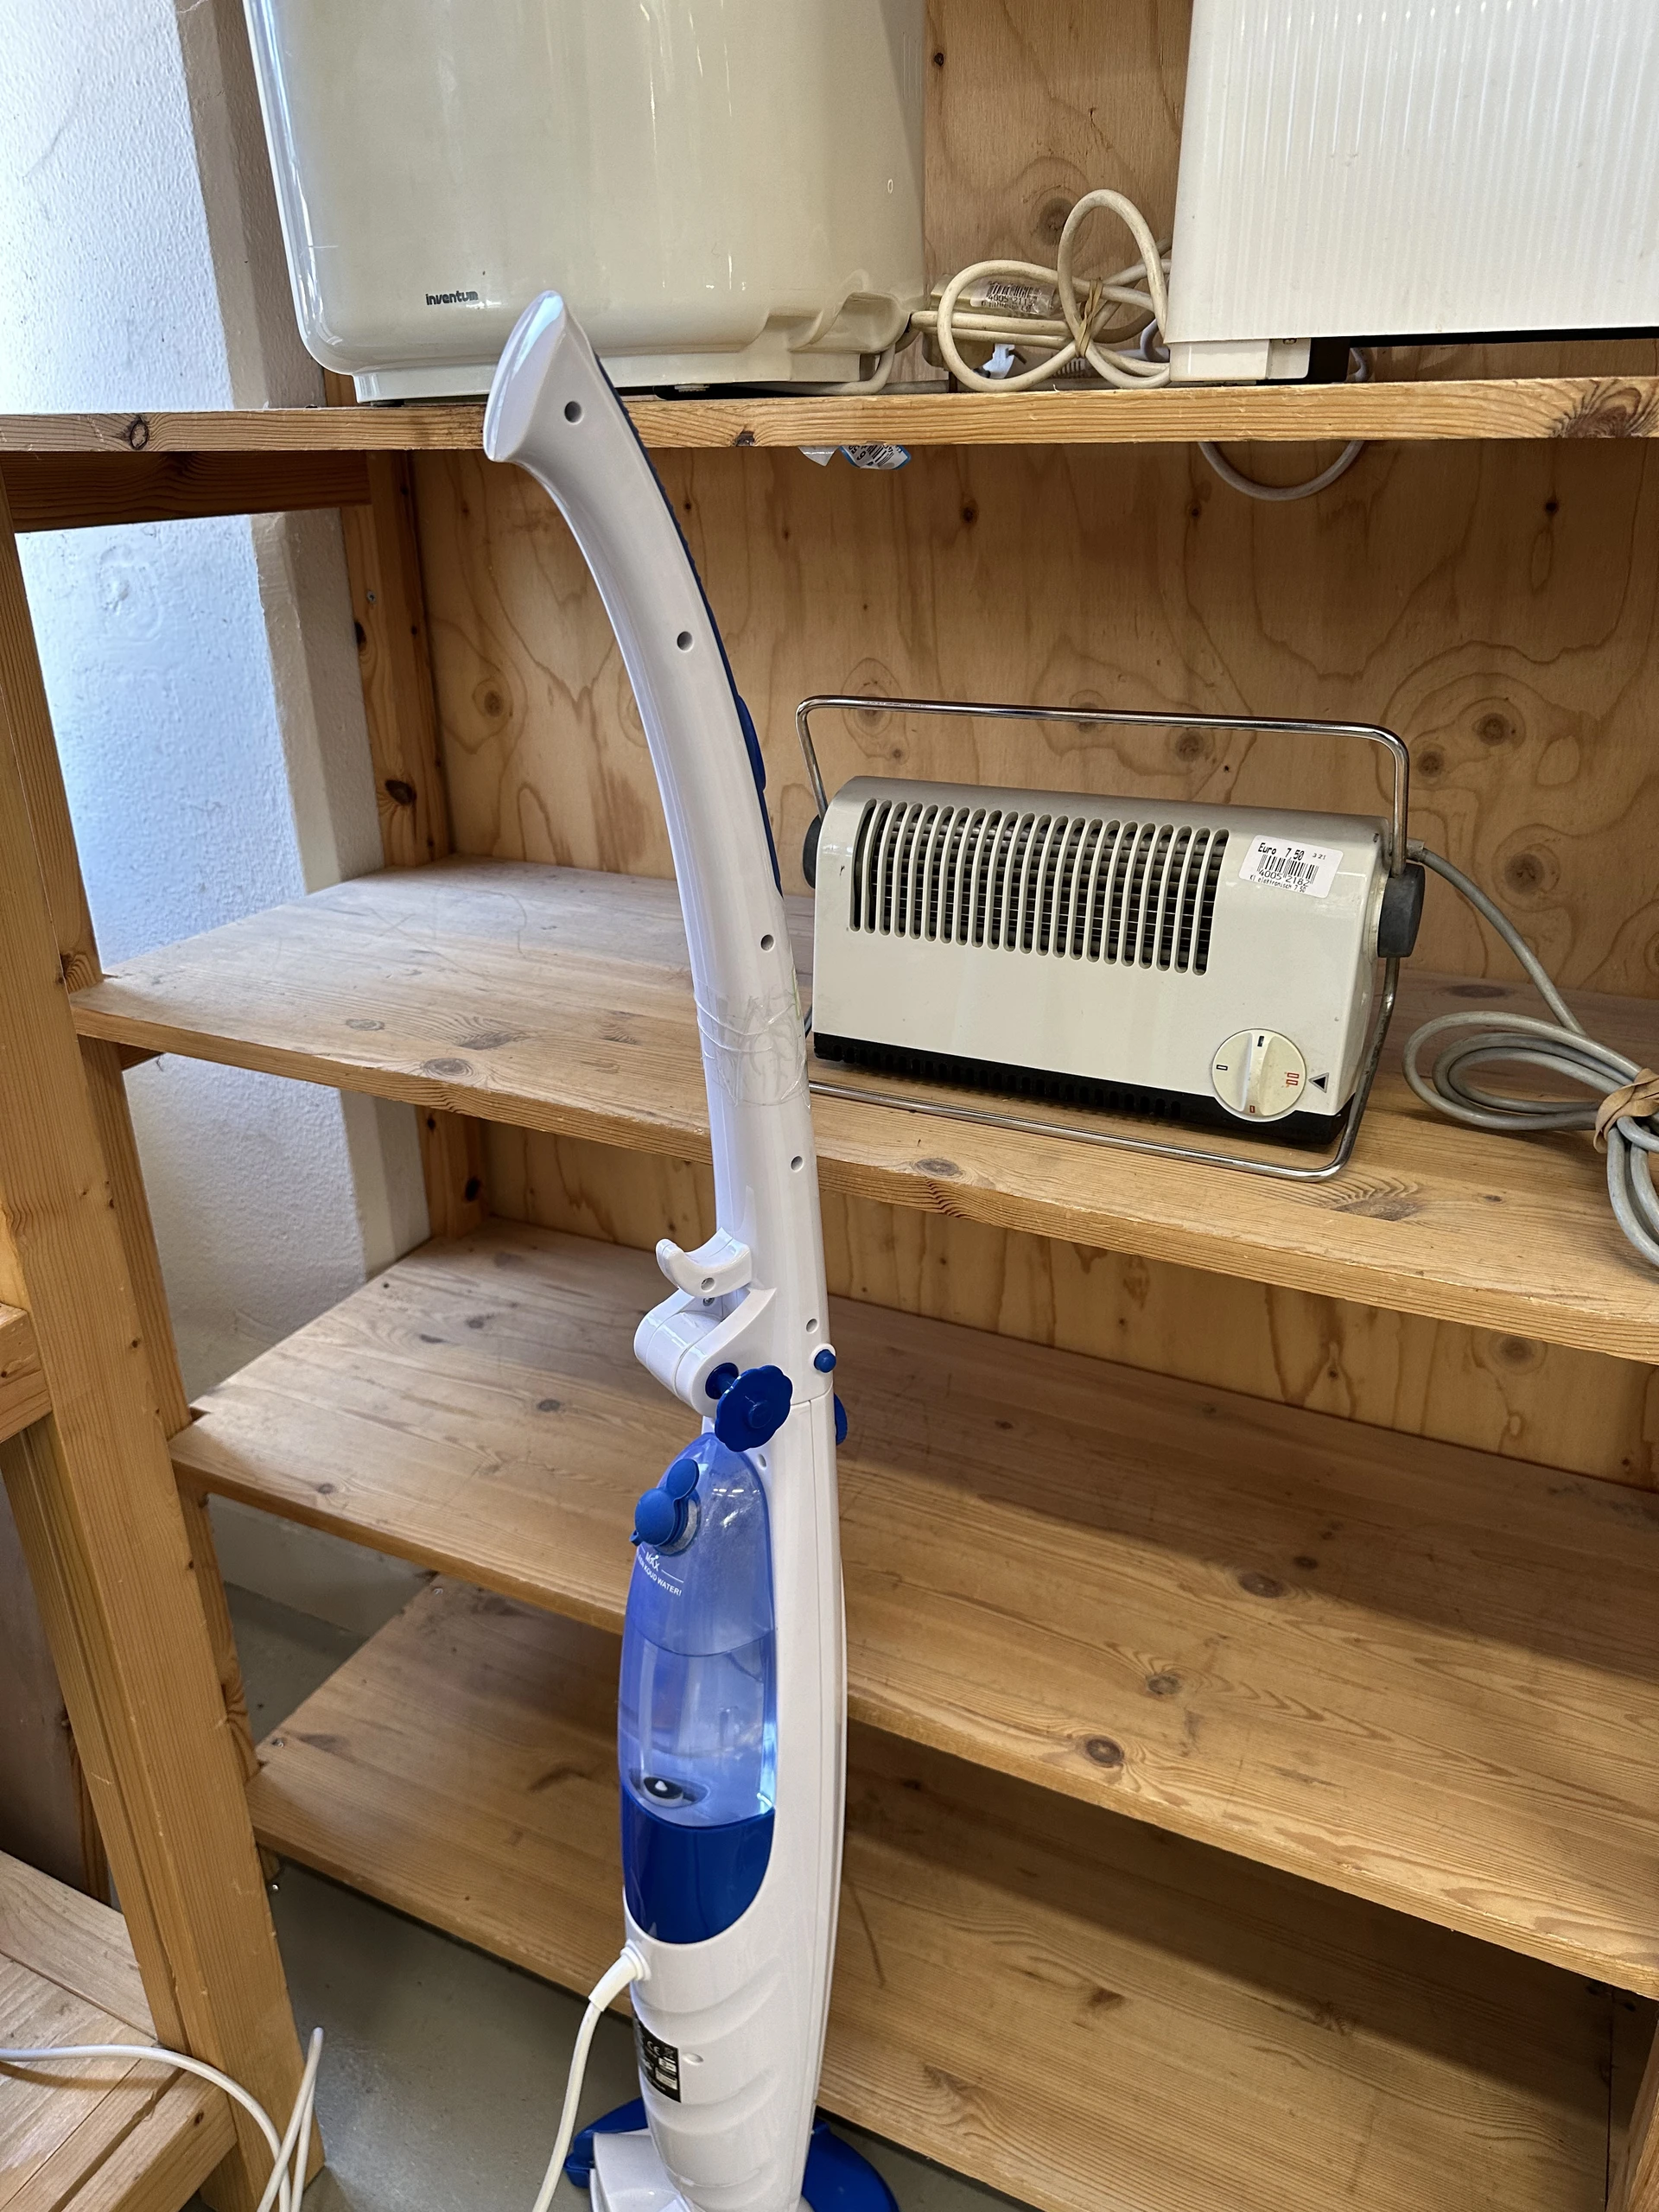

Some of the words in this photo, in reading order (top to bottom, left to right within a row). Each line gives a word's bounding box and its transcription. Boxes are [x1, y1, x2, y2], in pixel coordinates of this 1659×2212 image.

[425, 290, 479, 305] inventum
[1258, 842, 1277, 855] Euro
[1259, 869, 1282, 880] 4005
[1285, 875, 1310, 887] 2182
